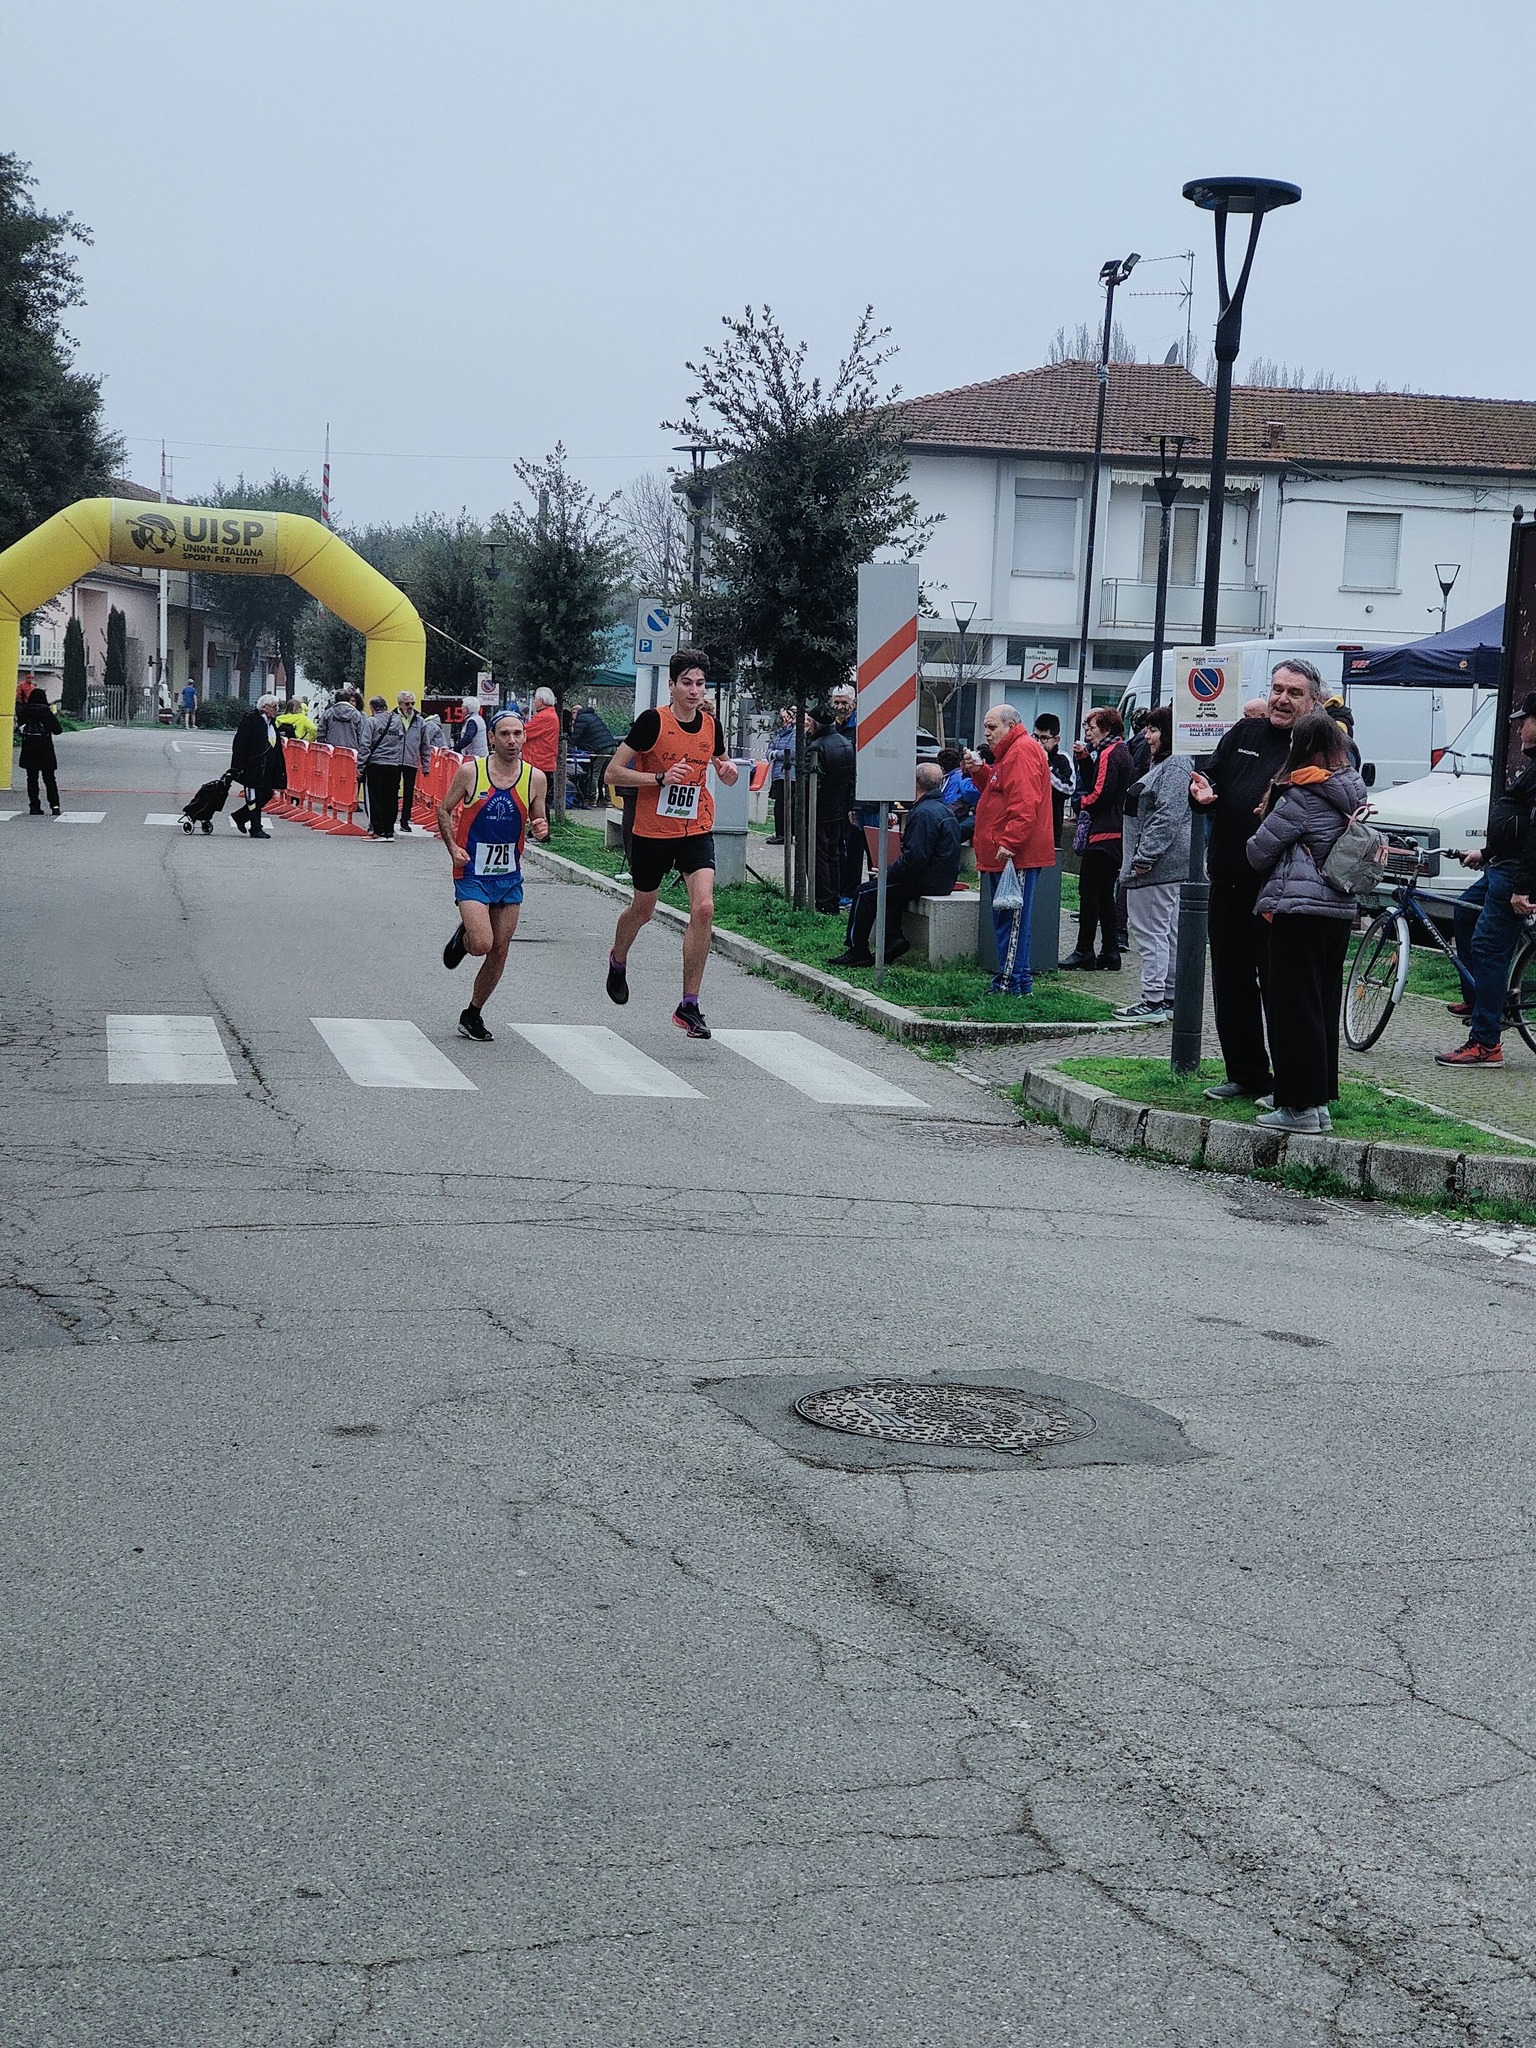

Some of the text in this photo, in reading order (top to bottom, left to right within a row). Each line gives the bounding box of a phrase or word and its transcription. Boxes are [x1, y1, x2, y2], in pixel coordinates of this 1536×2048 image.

[183, 516, 264, 546] UISP
[182, 544, 263, 558] UNIONE ITALIANA
[182, 553, 258, 565] SPORT PER TUTTI
[667, 785, 695, 807] 666
[485, 844, 509, 865] 726
